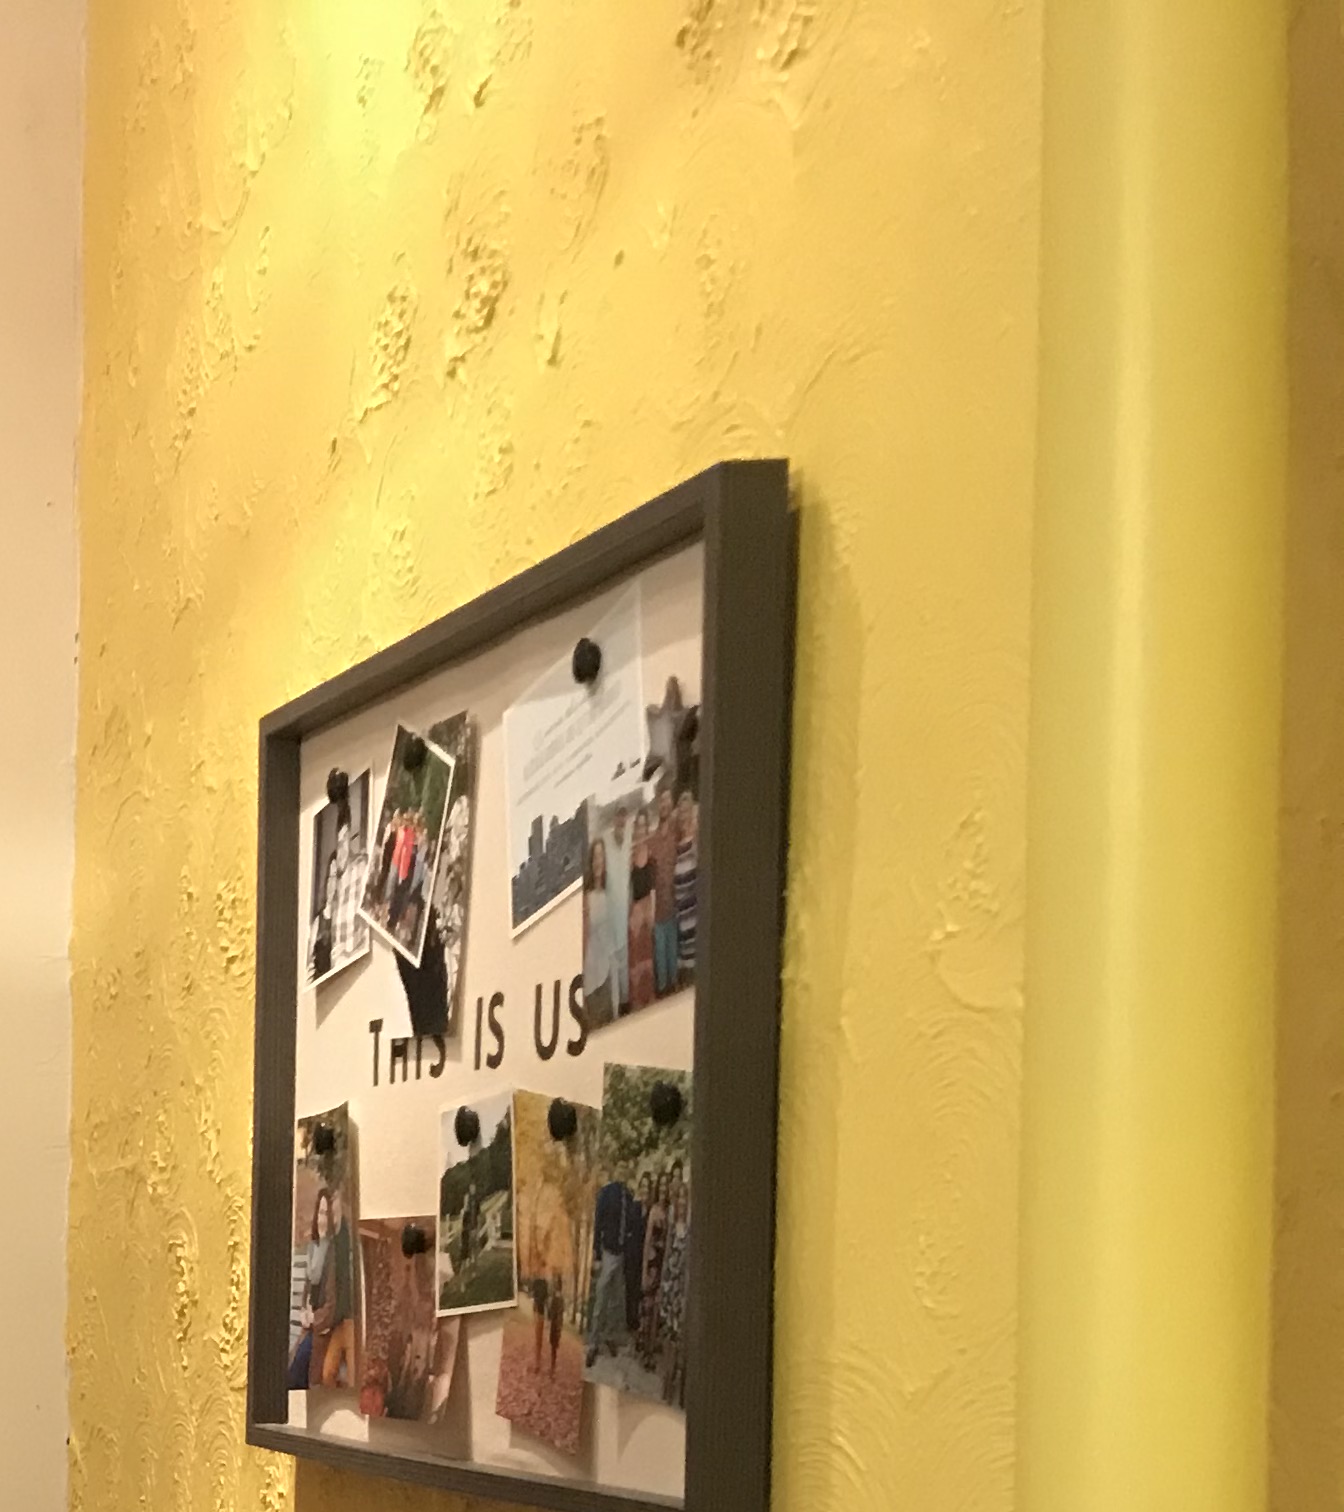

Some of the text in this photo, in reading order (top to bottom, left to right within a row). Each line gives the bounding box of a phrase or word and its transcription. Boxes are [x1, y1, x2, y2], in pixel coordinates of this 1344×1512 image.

[368, 973, 590, 1087] THIS IS US
